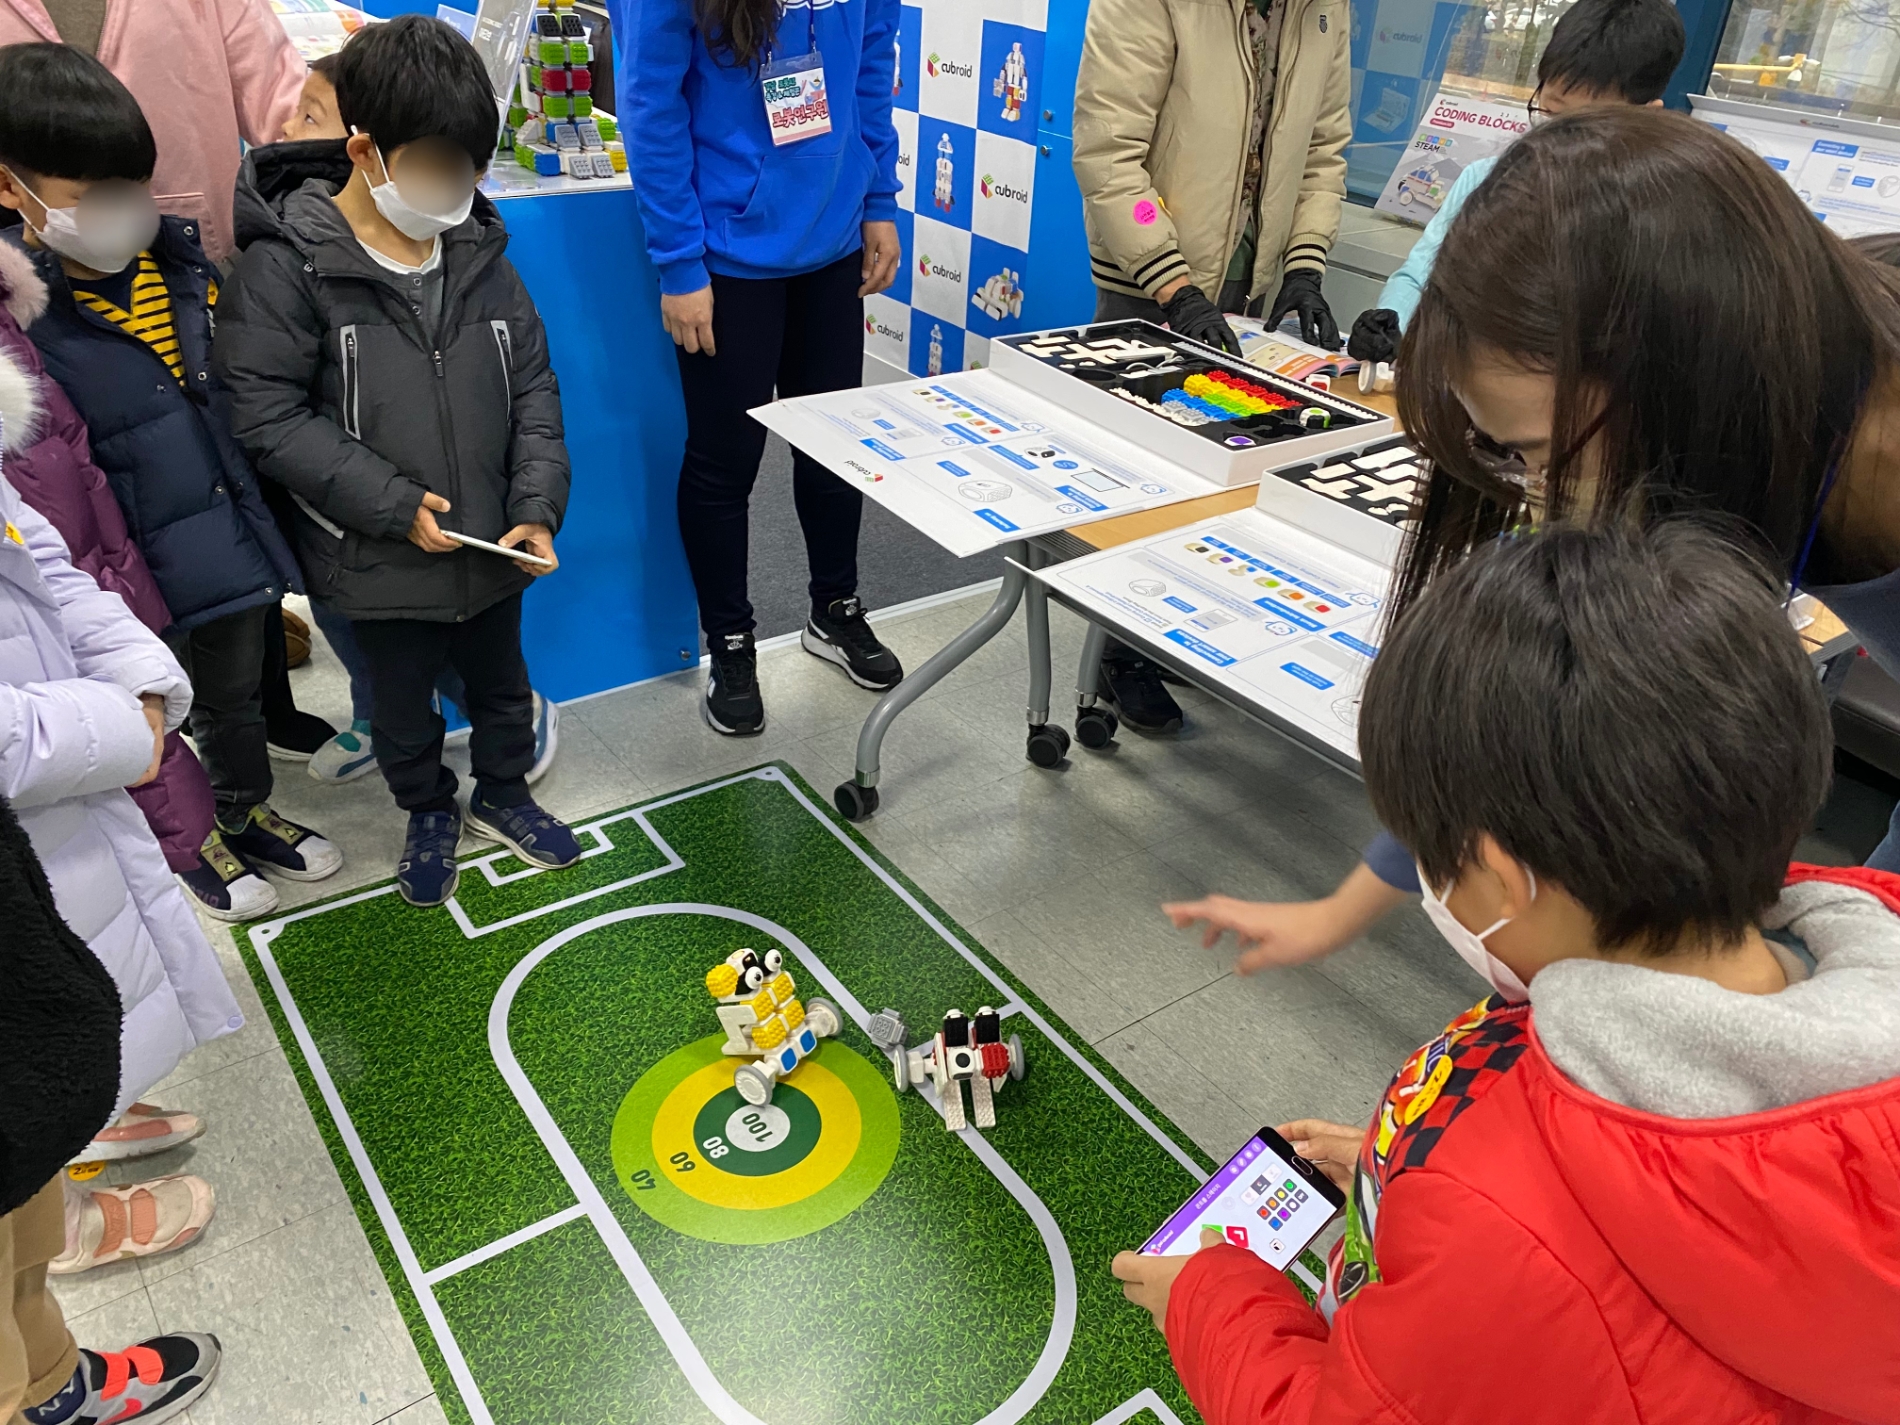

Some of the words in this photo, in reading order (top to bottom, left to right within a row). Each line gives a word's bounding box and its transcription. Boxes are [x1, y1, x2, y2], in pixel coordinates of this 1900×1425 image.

[941, 60, 973, 78] cubroid
[772, 99, 829, 128] 로봇연구원
[1434, 106, 1478, 124] CODING
[1477, 114, 1528, 134] BLOCKS
[1414, 141, 1440, 152] STEAM
[995, 184, 1028, 204] cubroid
[932, 264, 962, 283] cubroid
[877, 324, 904, 342] cubroid
[844, 460, 871, 475] cubroid
[1264, 600, 1300, 619] Introduction
[1299, 618, 1318, 629] Block
[1176, 630, 1200, 643] devices
[1190, 644, 1224, 664] Connecting
[1197, 642, 1218, 654] smart
[1215, 652, 1232, 662] your
[741, 1112, 773, 1143] 100
[702, 1136, 730, 1159] 80
[669, 1151, 696, 1173] 60
[630, 1168, 657, 1191] 40
[1195, 1197, 1208, 1210] 콘트롤
[1206, 1183, 1221, 1200] 스테이지
